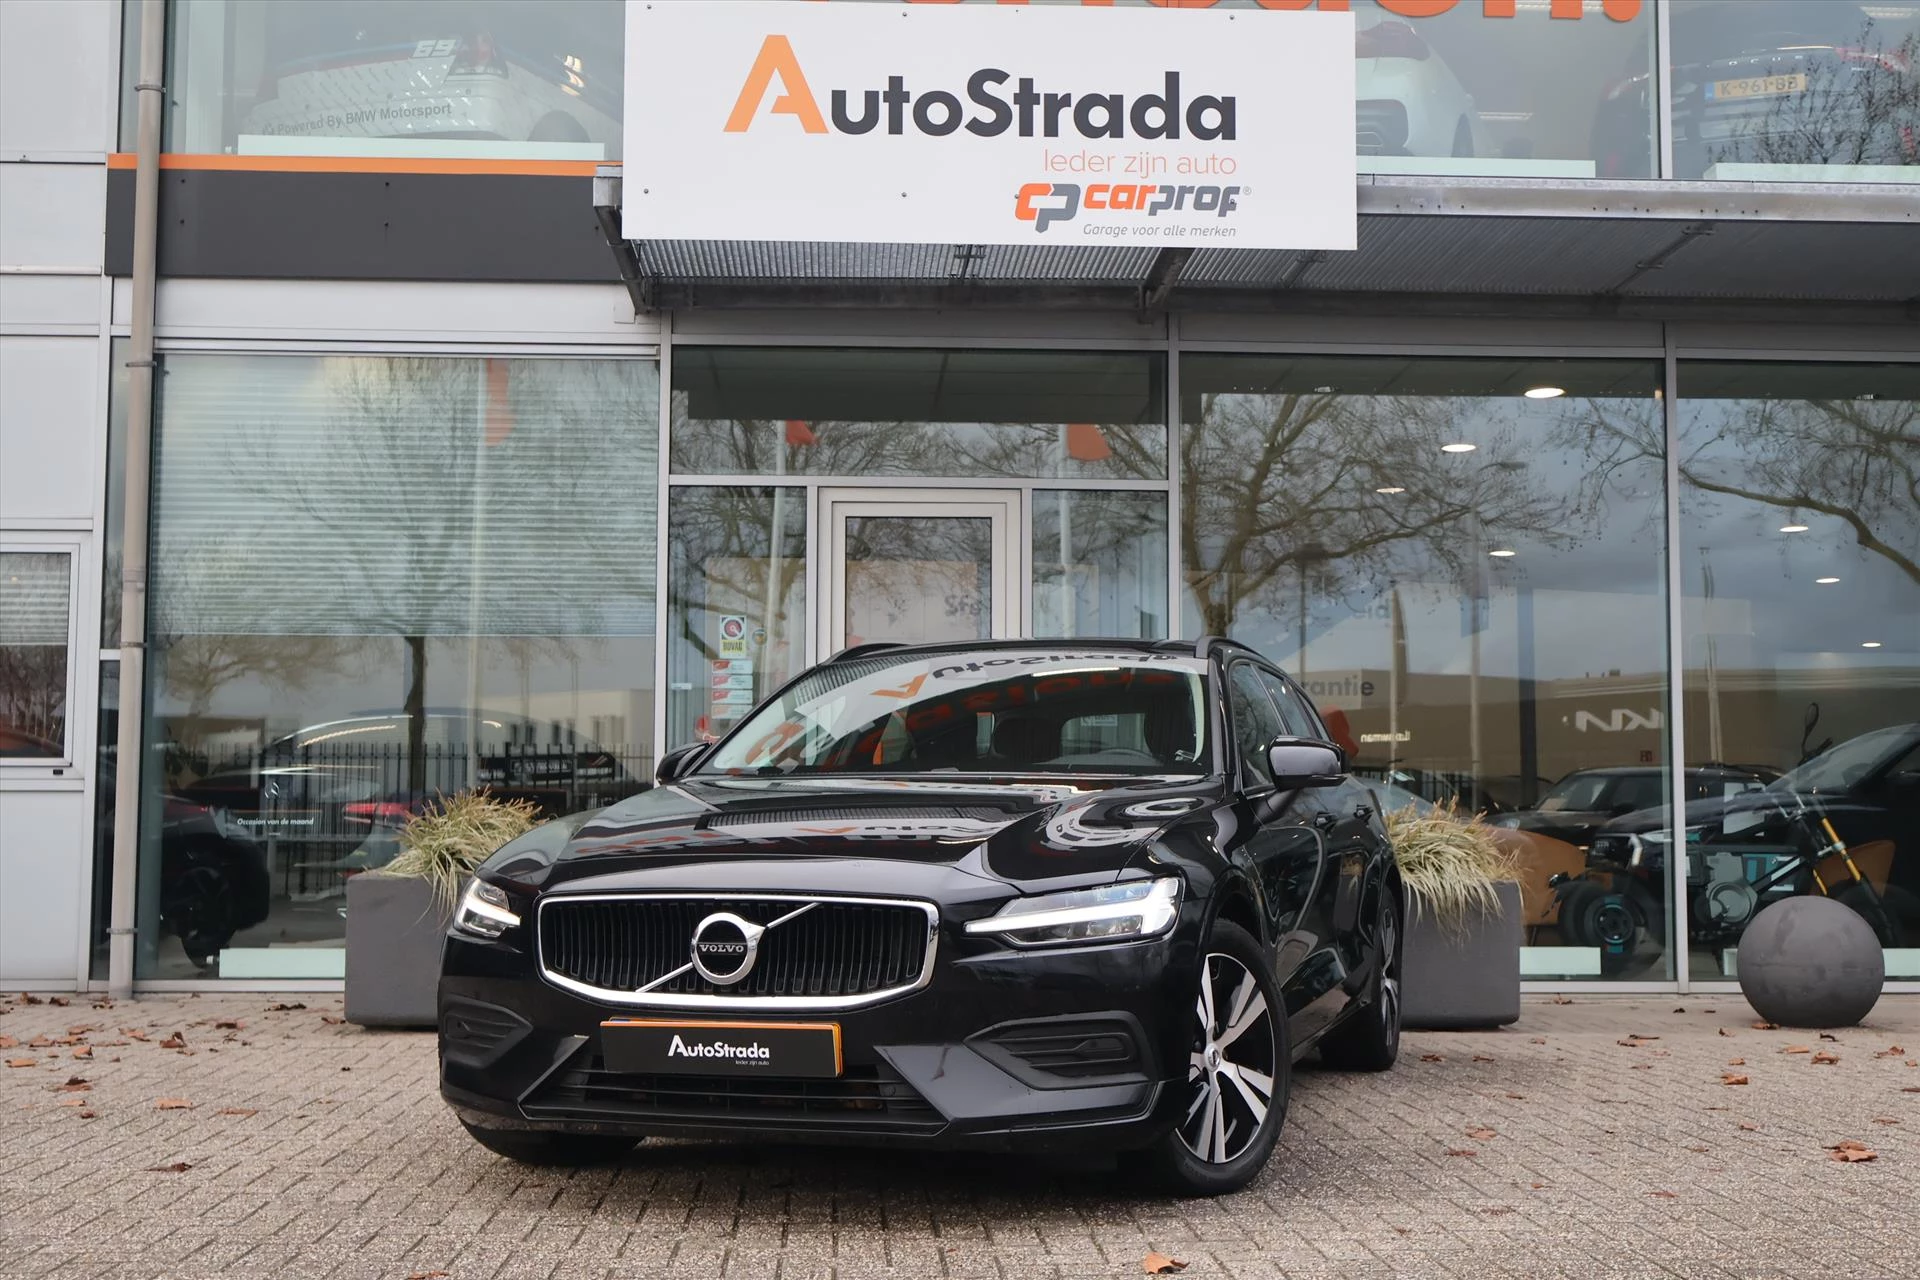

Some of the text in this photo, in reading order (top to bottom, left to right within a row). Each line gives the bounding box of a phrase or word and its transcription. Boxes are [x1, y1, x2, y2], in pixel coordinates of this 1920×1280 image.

[412, 39, 456, 57] 69
[723, 34, 1237, 141] AutoStrada
[277, 103, 453, 135] Powered By BMW Motorsport
[1044, 149, 1237, 179] Ieder zijn auto
[1083, 224, 1237, 239] Garage voor alle merken
[1302, 674, 1375, 697] rantie
[237, 817, 266, 825] Occasion
[281, 817, 290, 825] de
[291, 817, 314, 825] maand
[699, 944, 744, 953] VOLVO
[668, 1034, 770, 1059] AutoStrada
